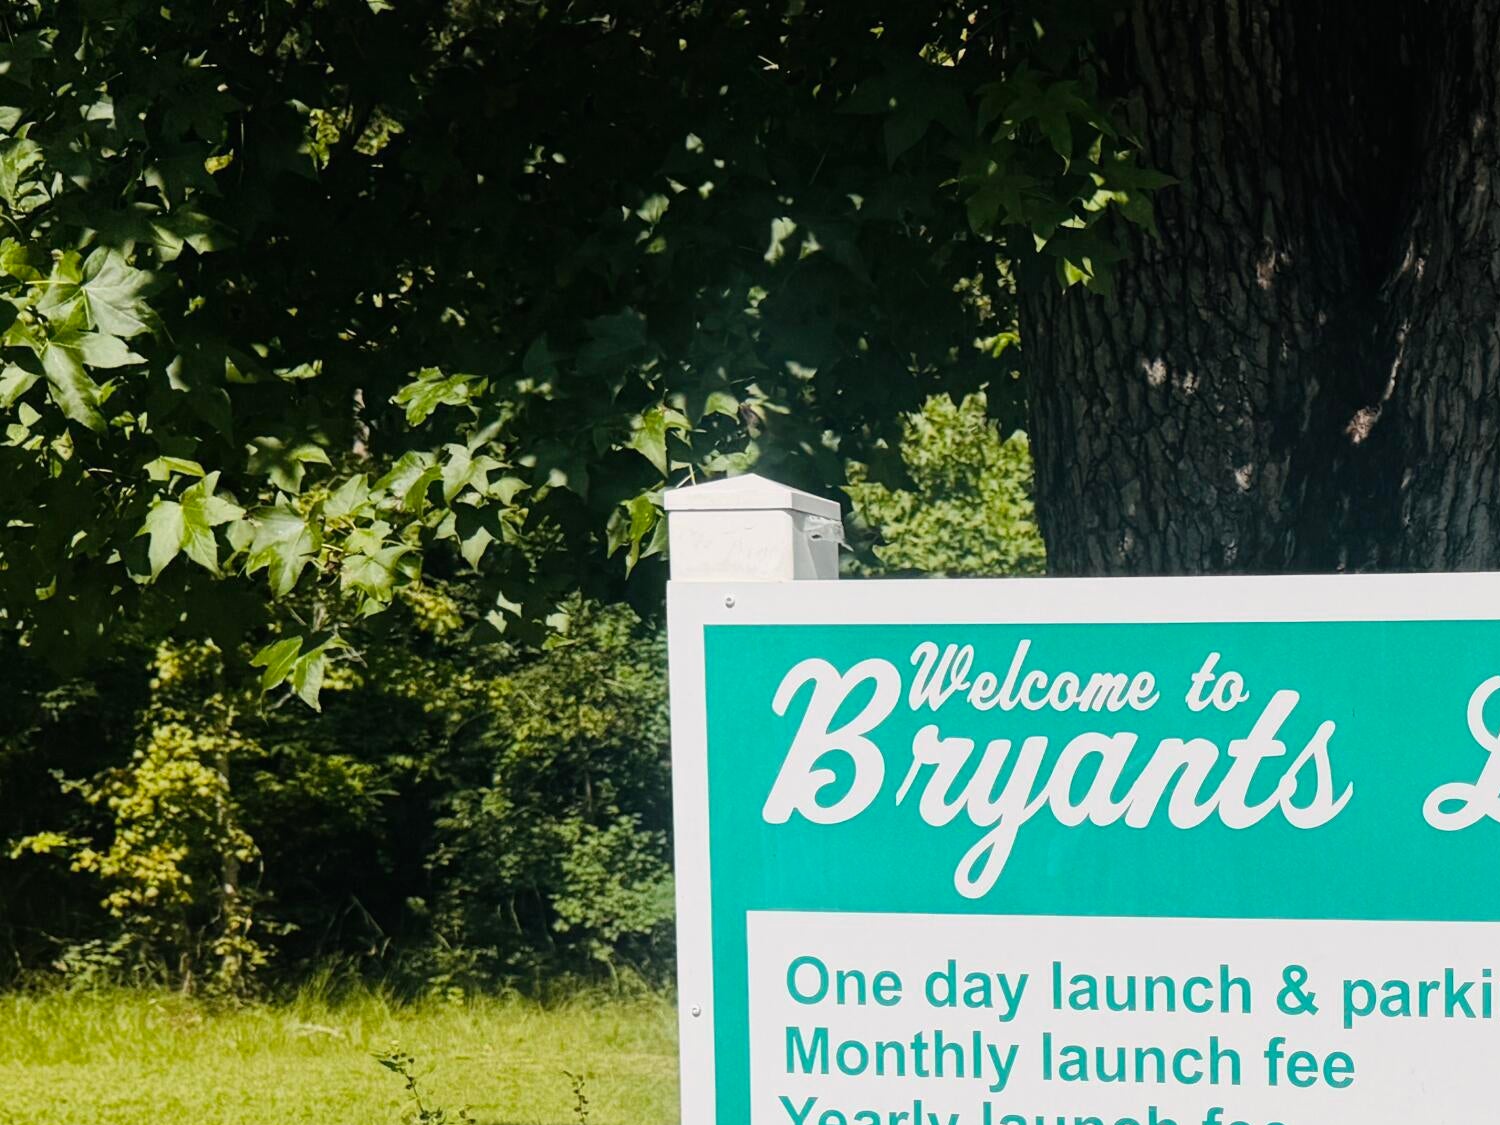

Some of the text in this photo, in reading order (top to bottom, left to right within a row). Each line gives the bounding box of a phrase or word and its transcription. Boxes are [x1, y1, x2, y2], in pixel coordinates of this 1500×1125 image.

[909, 640, 1248, 711] Welcome to
[763, 658, 1352, 898] Bryants
[787, 956, 902, 1006] One
[925, 960, 1028, 1022] day
[1053, 961, 1251, 1013] launch
[1277, 965, 1318, 1015] &
[786, 1027, 1018, 1092] Monthly
[1043, 1033, 1241, 1085] launch
[1264, 1037, 1354, 1088] fee
